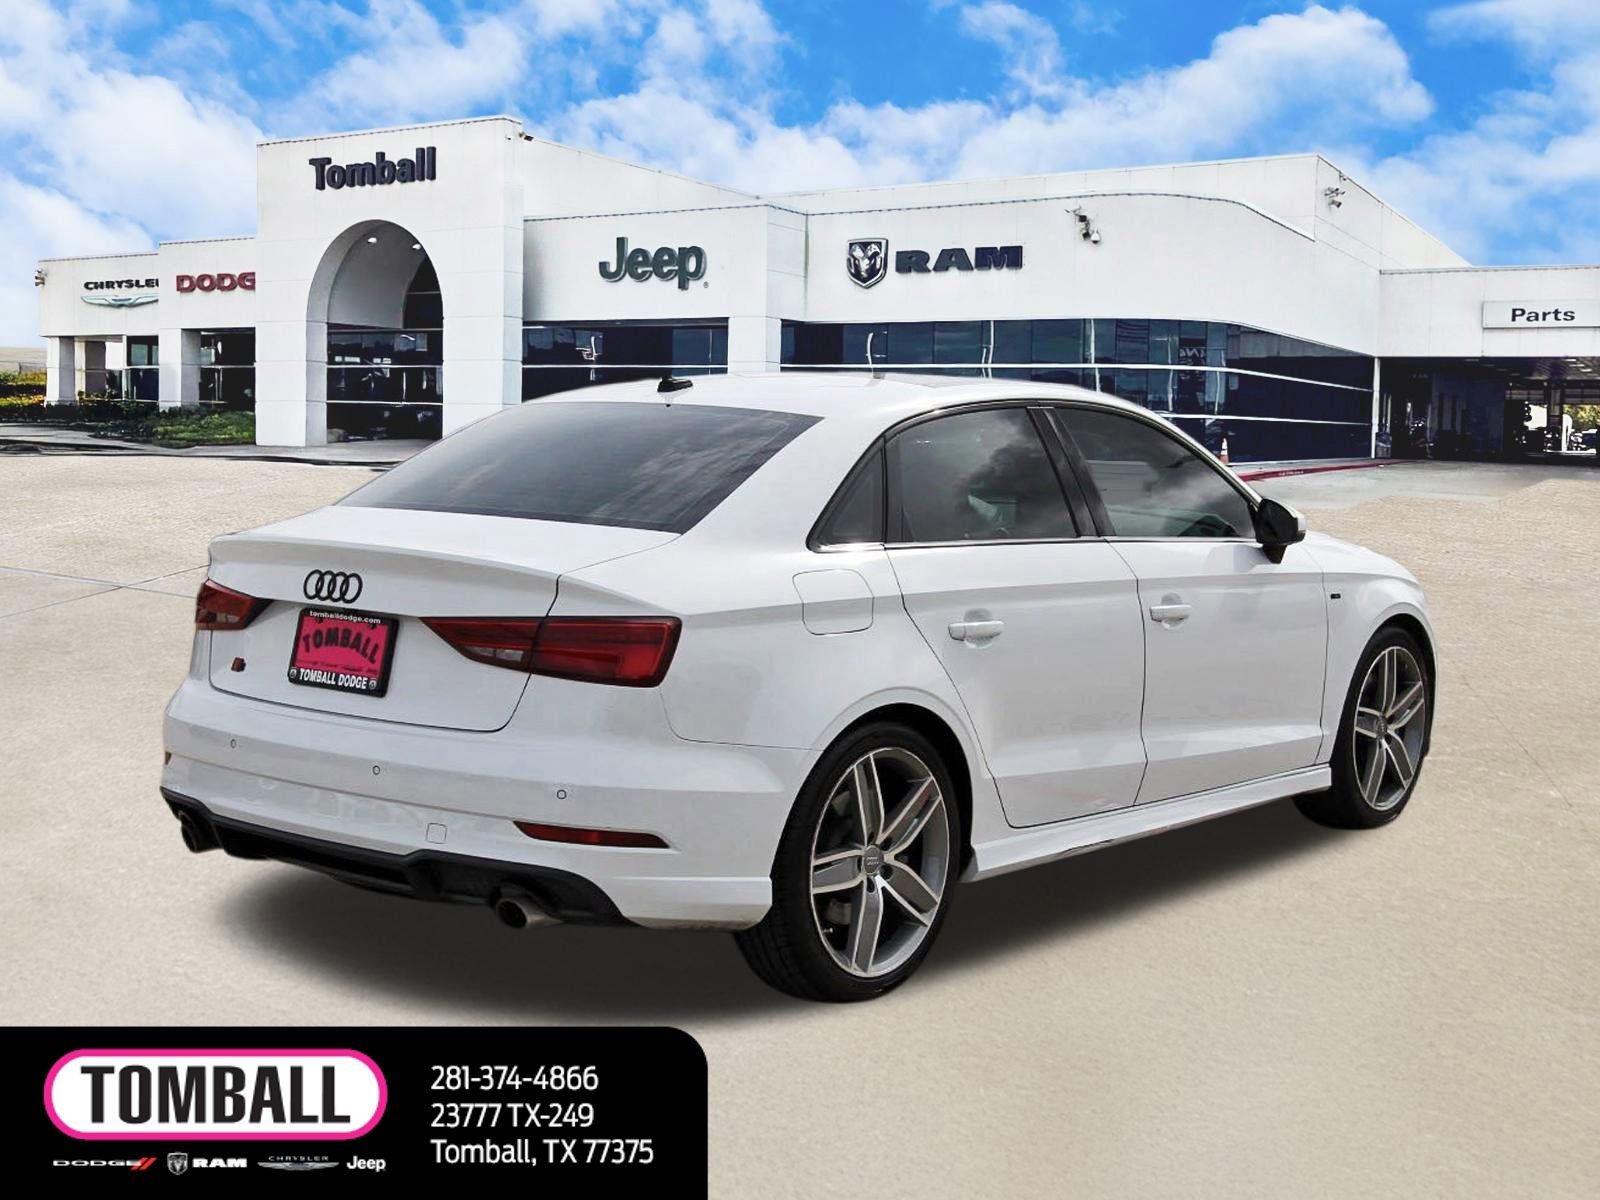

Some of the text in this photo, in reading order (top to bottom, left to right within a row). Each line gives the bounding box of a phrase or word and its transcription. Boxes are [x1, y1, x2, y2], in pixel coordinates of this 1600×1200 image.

[308, 146, 437, 191] Tomball
[599, 236, 707, 290] Jeep
[895, 245, 1024, 274] RAM
[83, 278, 159, 290] CHRYSLE
[1511, 307, 1576, 322] Parts
[302, 626, 379, 665] TOMBALL
[299, 668, 368, 689] TOMBALL DODGE
